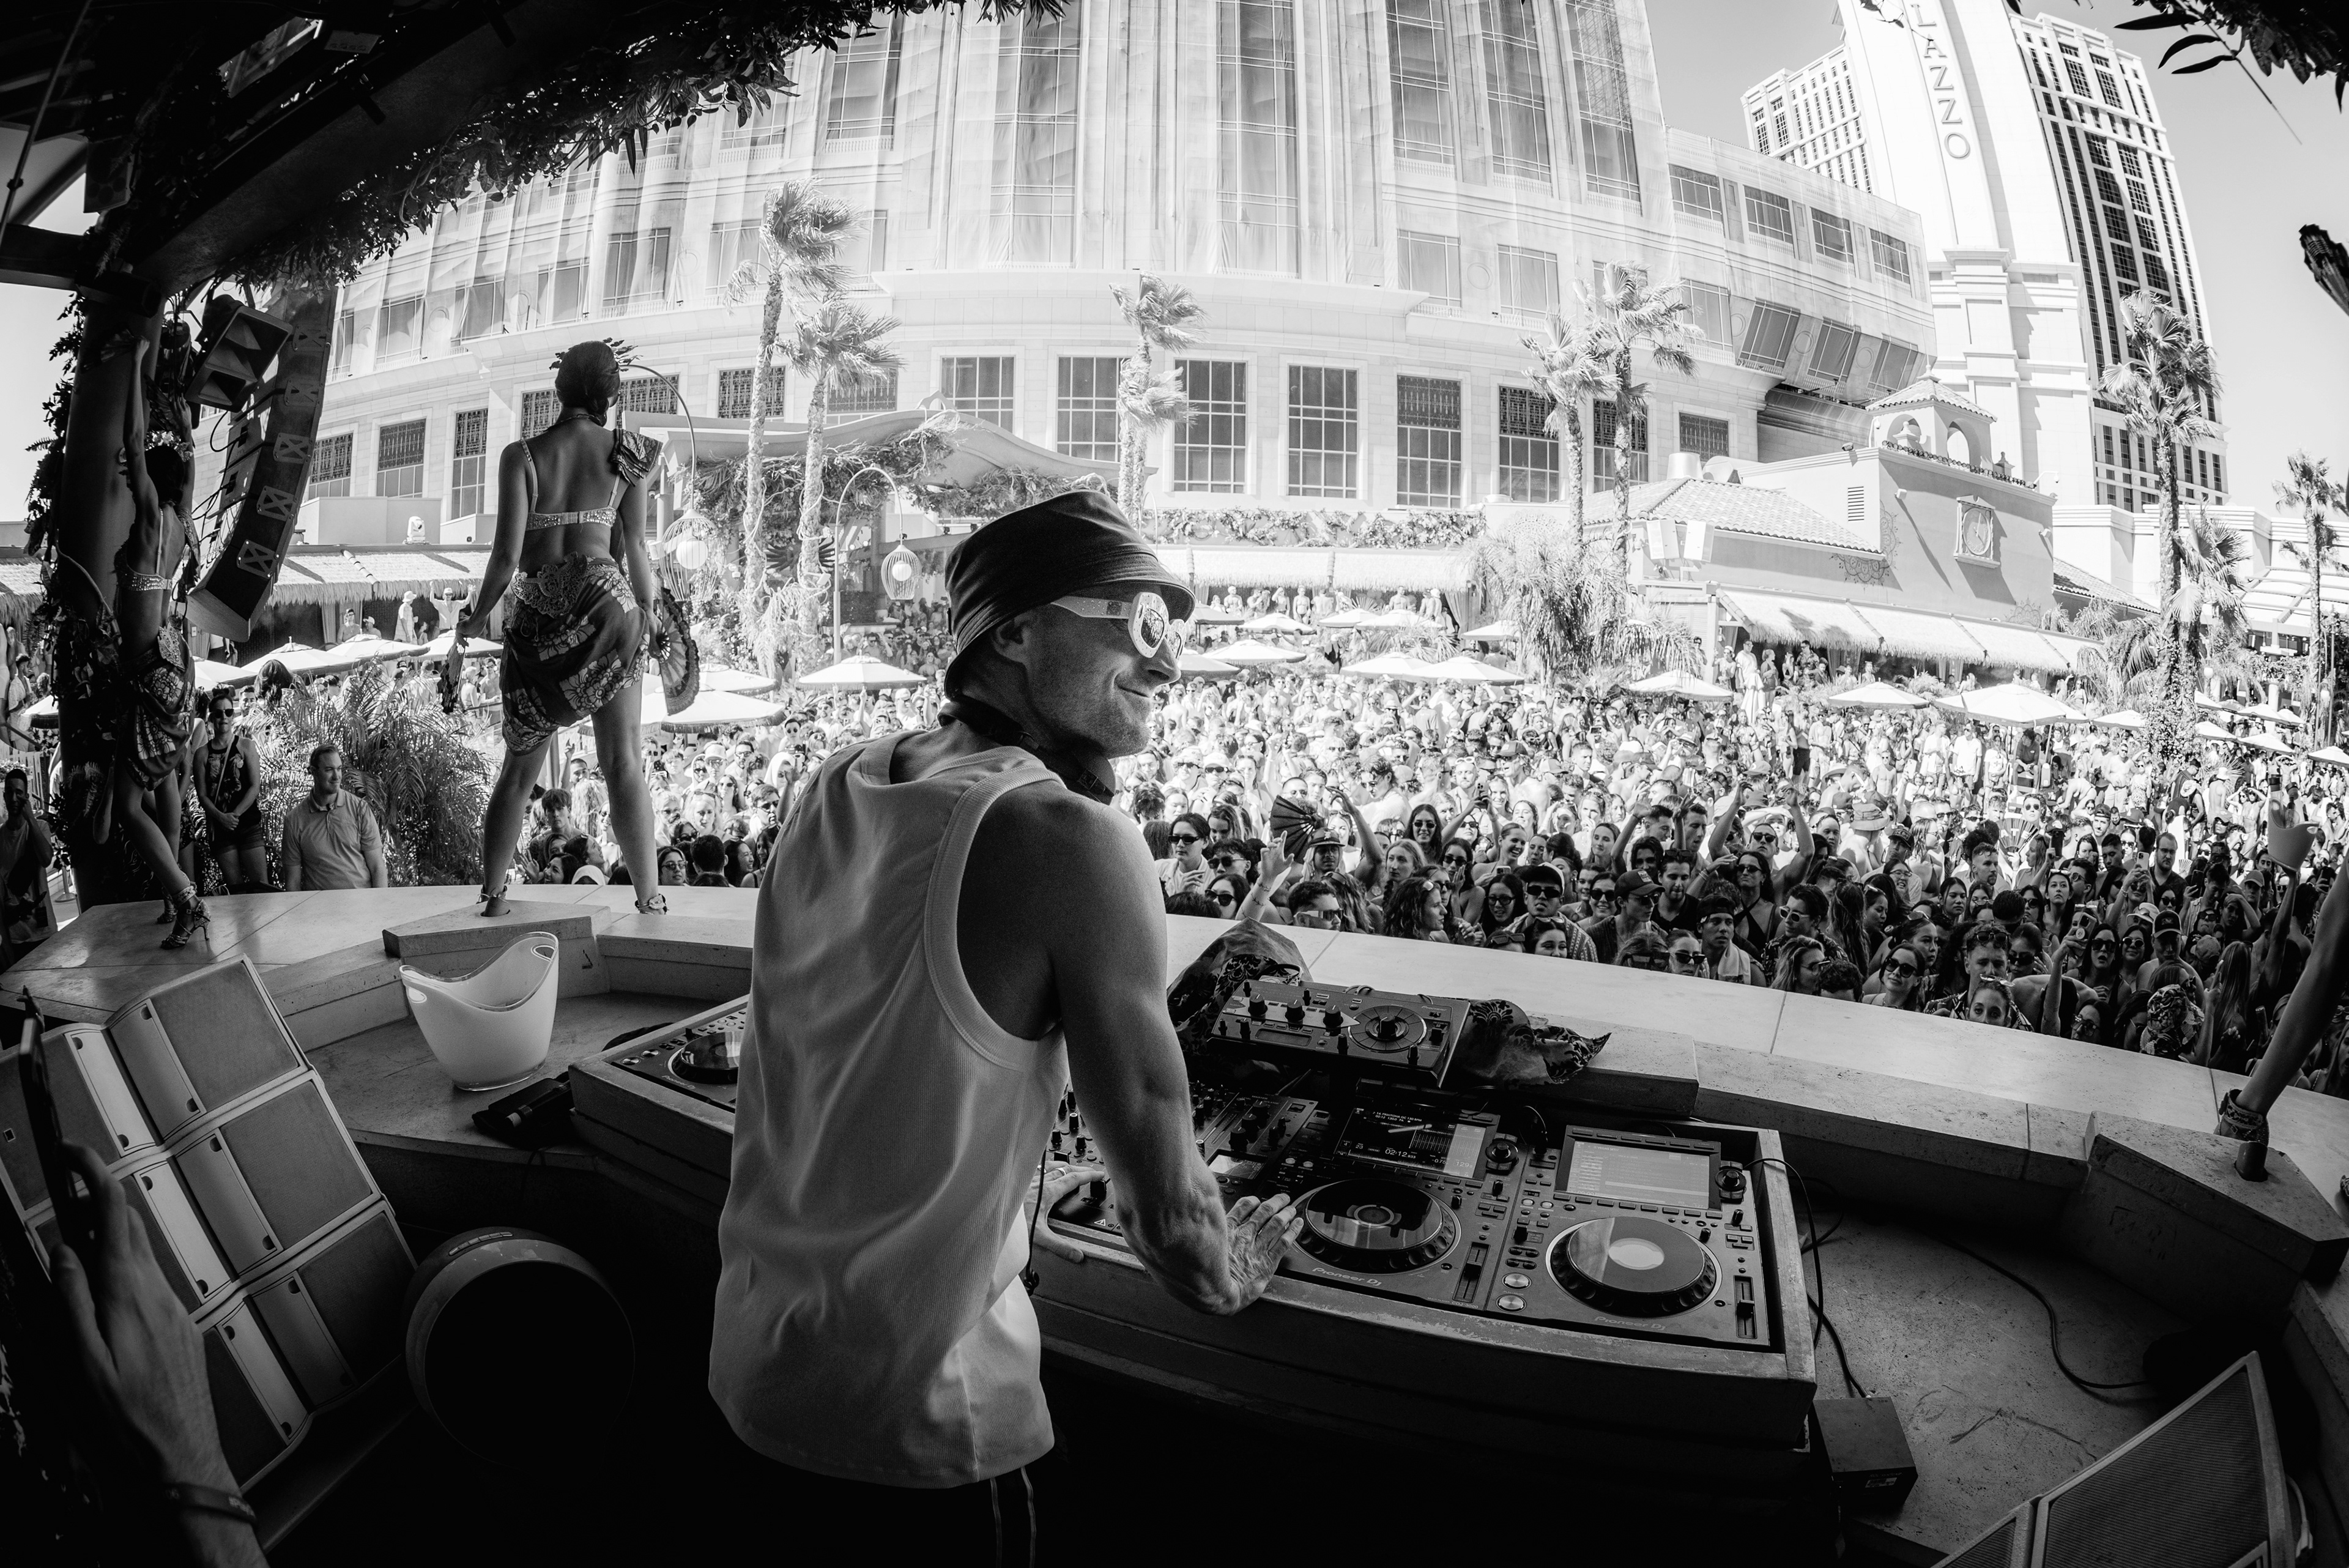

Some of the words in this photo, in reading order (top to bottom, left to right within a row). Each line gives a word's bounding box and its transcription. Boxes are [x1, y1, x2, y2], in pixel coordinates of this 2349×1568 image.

[1312, 1266, 1365, 1282] Pioneer
[1452, 1301, 1479, 1309] CDJ-3000
[1594, 1315, 1649, 1328] Pioneer
